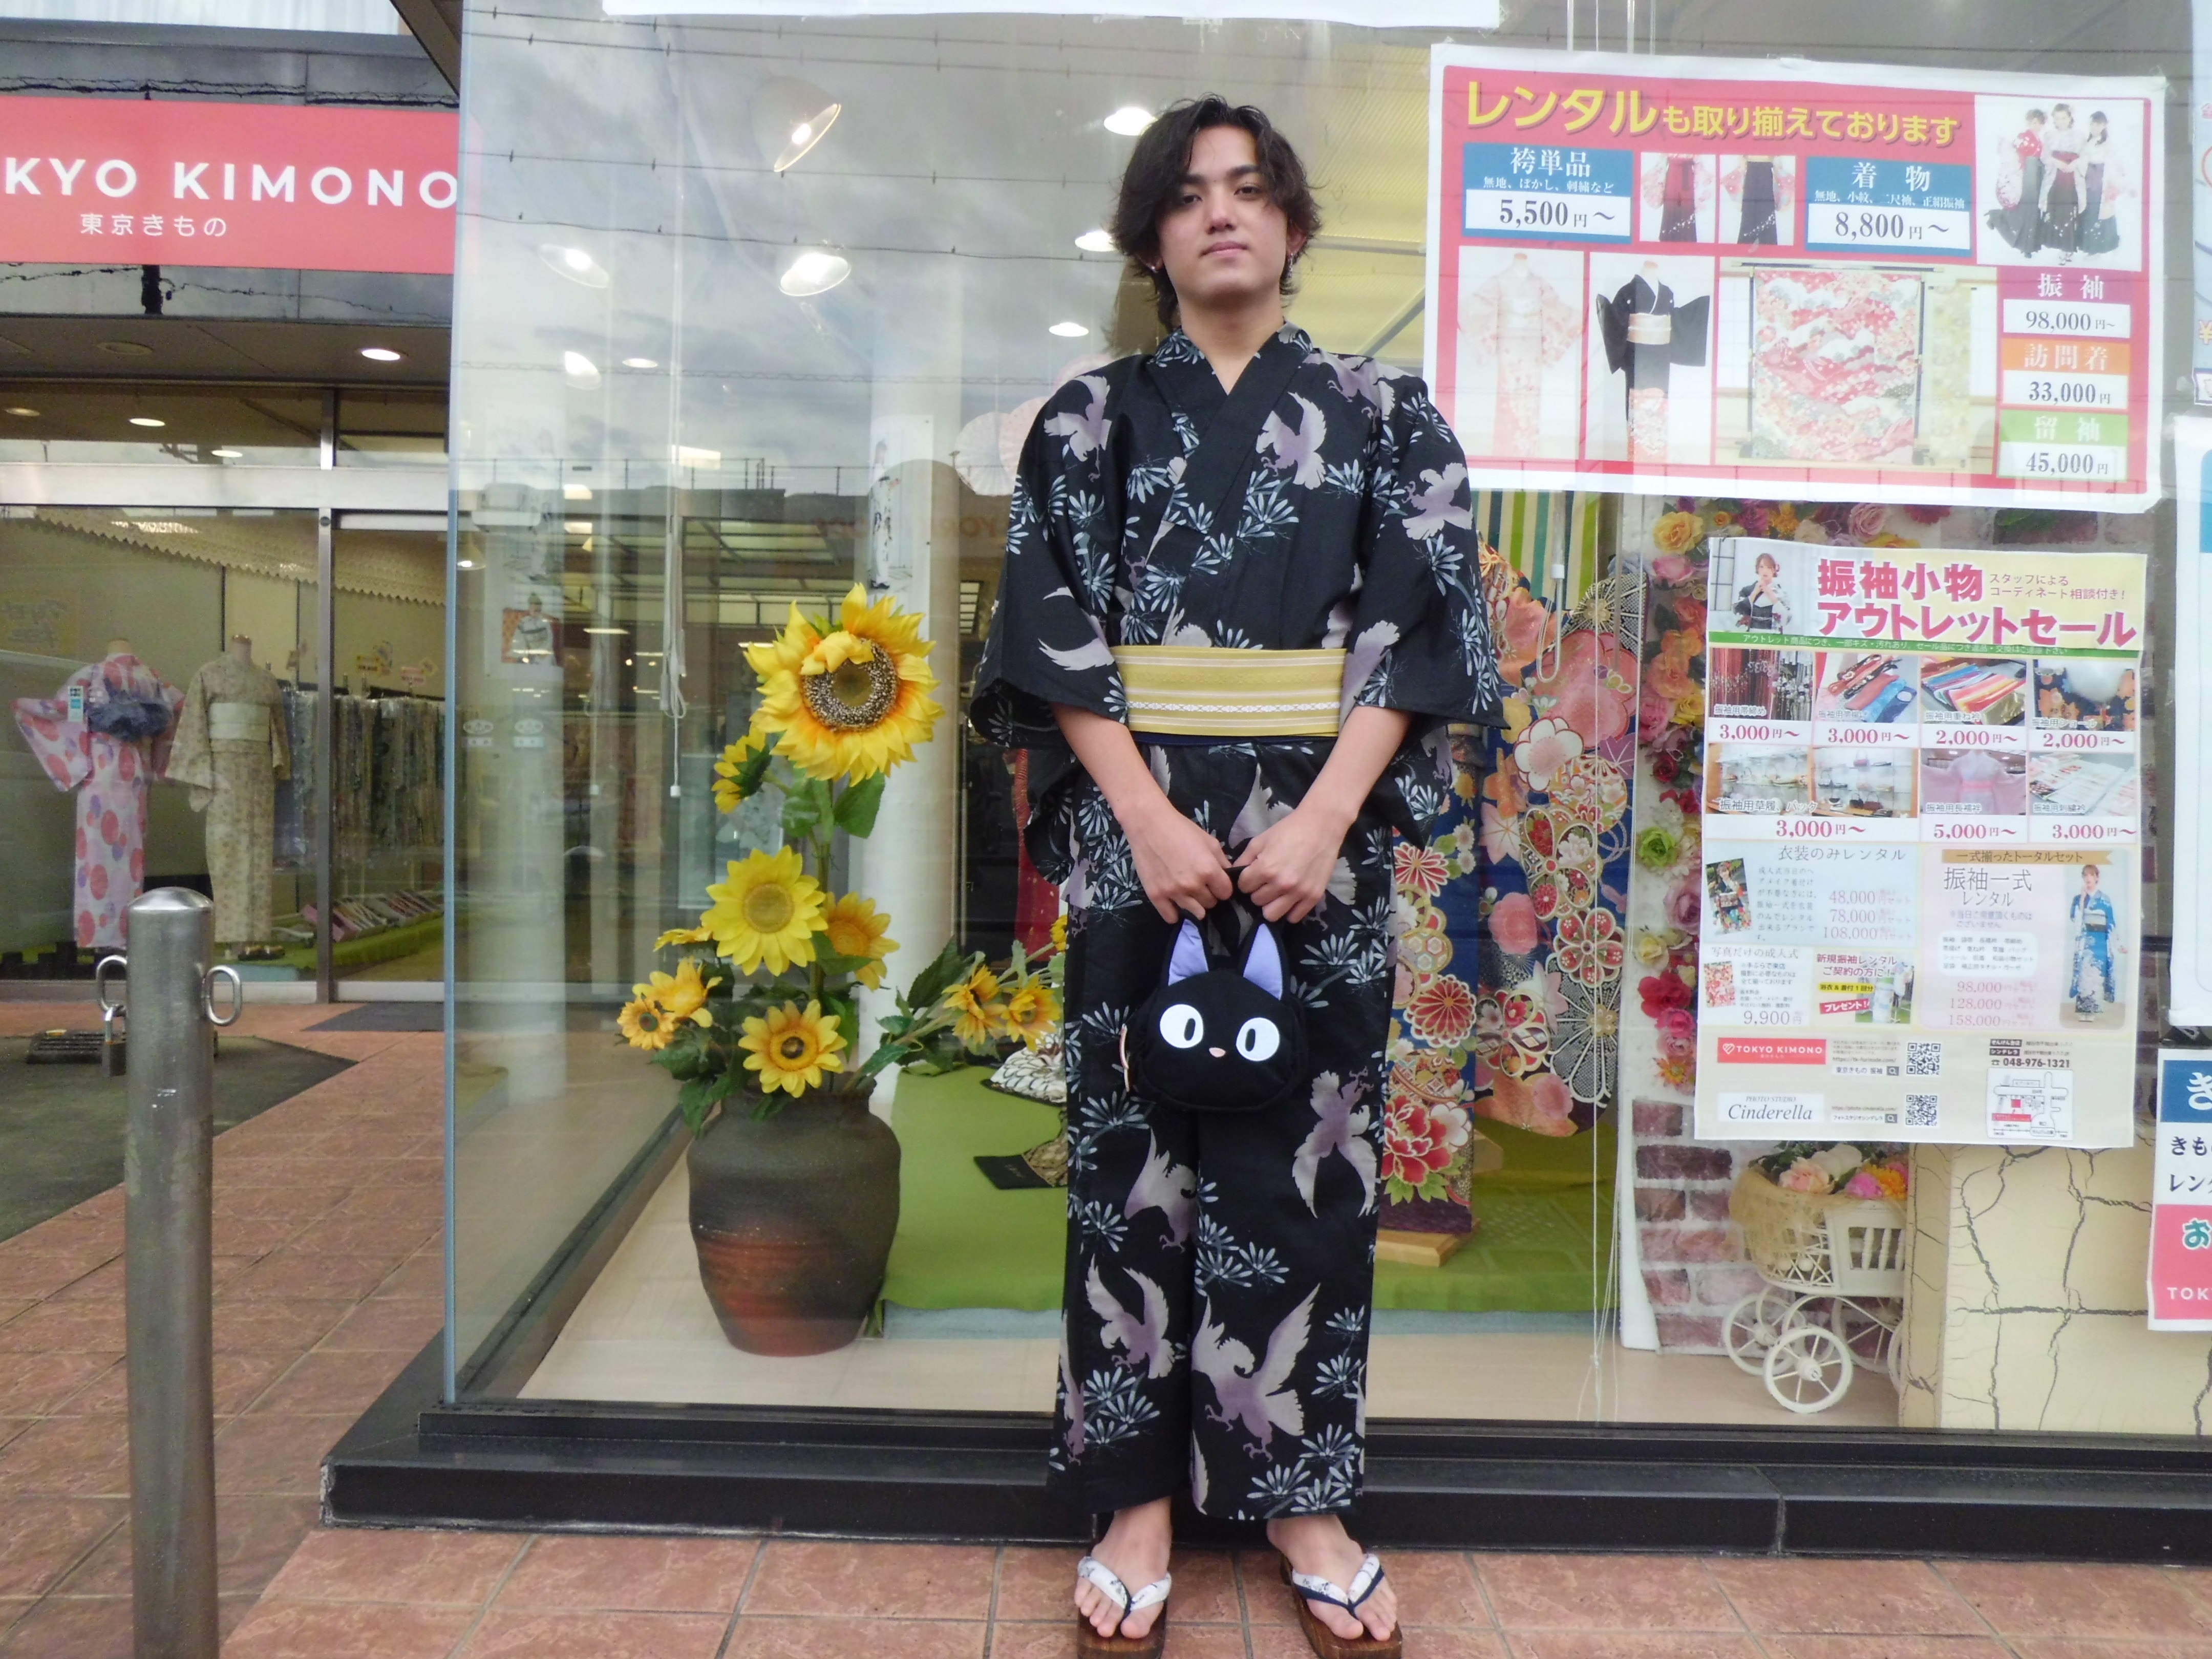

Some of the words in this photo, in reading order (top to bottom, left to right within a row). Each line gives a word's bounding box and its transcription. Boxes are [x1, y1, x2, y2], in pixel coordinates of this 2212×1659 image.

[1511, 147, 1590, 177] 袴単品
[174, 162, 457, 208] KIMONO
[80, 213, 227, 237] 東京きもの
[2024, 344, 2107, 371] 訪問着
[1818, 558, 1983, 602] 振袖小物
[1990, 573, 2069, 586] スタッフによる
[1818, 602, 2137, 647] アウトレットセール
[1778, 845, 1906, 861] 衣装のみレンタル
[1944, 867, 2032, 891] 振袖一式
[1962, 892, 2014, 907] レンタル
[1712, 947, 1798, 959] 写真だけの成人式
[1817, 953, 1897, 965] 新規振袖レンタル
[2003, 1058, 2070, 1068] 048-976-1321
[1729, 1104, 1812, 1120] Cinderella
[2171, 1136, 2212, 1156] きも
[2167, 1287, 2212, 1301] TOK
